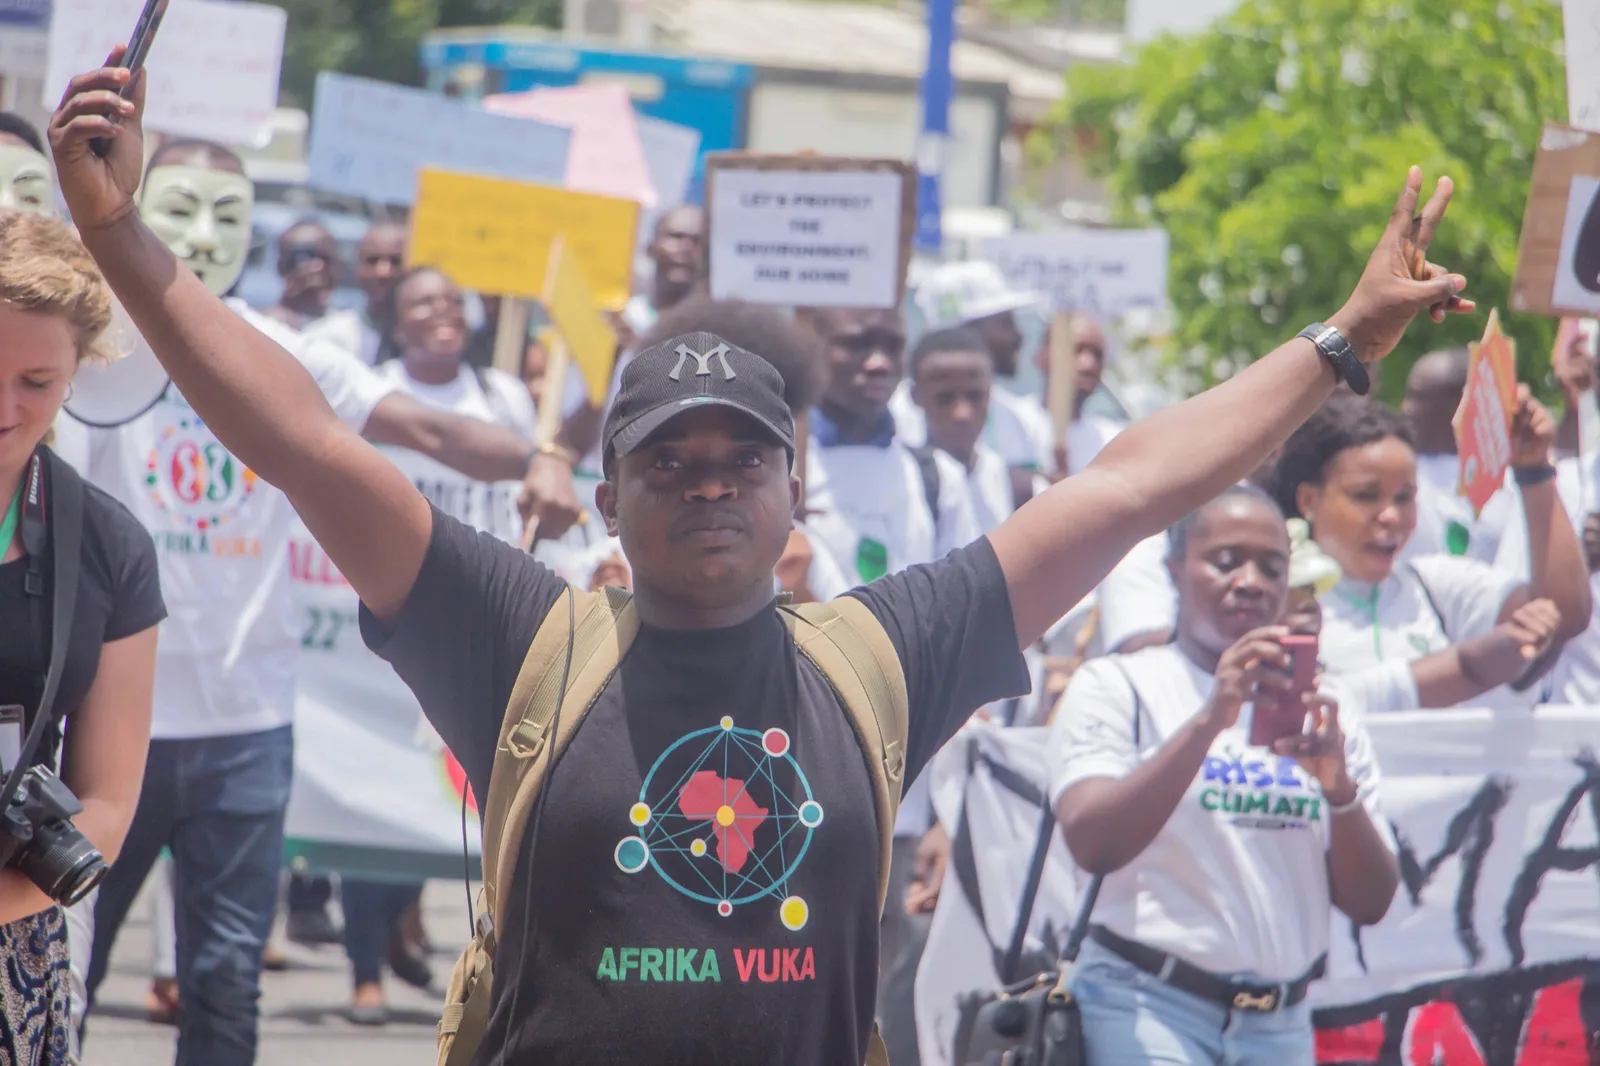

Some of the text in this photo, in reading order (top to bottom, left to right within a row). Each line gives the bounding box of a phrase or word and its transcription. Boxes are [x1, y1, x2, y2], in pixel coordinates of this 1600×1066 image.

[793, 194, 872, 210] PROTECT
[789, 218, 821, 233] THE
[754, 265, 850, 284] OUR HOME
[596, 946, 816, 983] AFRIKA VUKA
